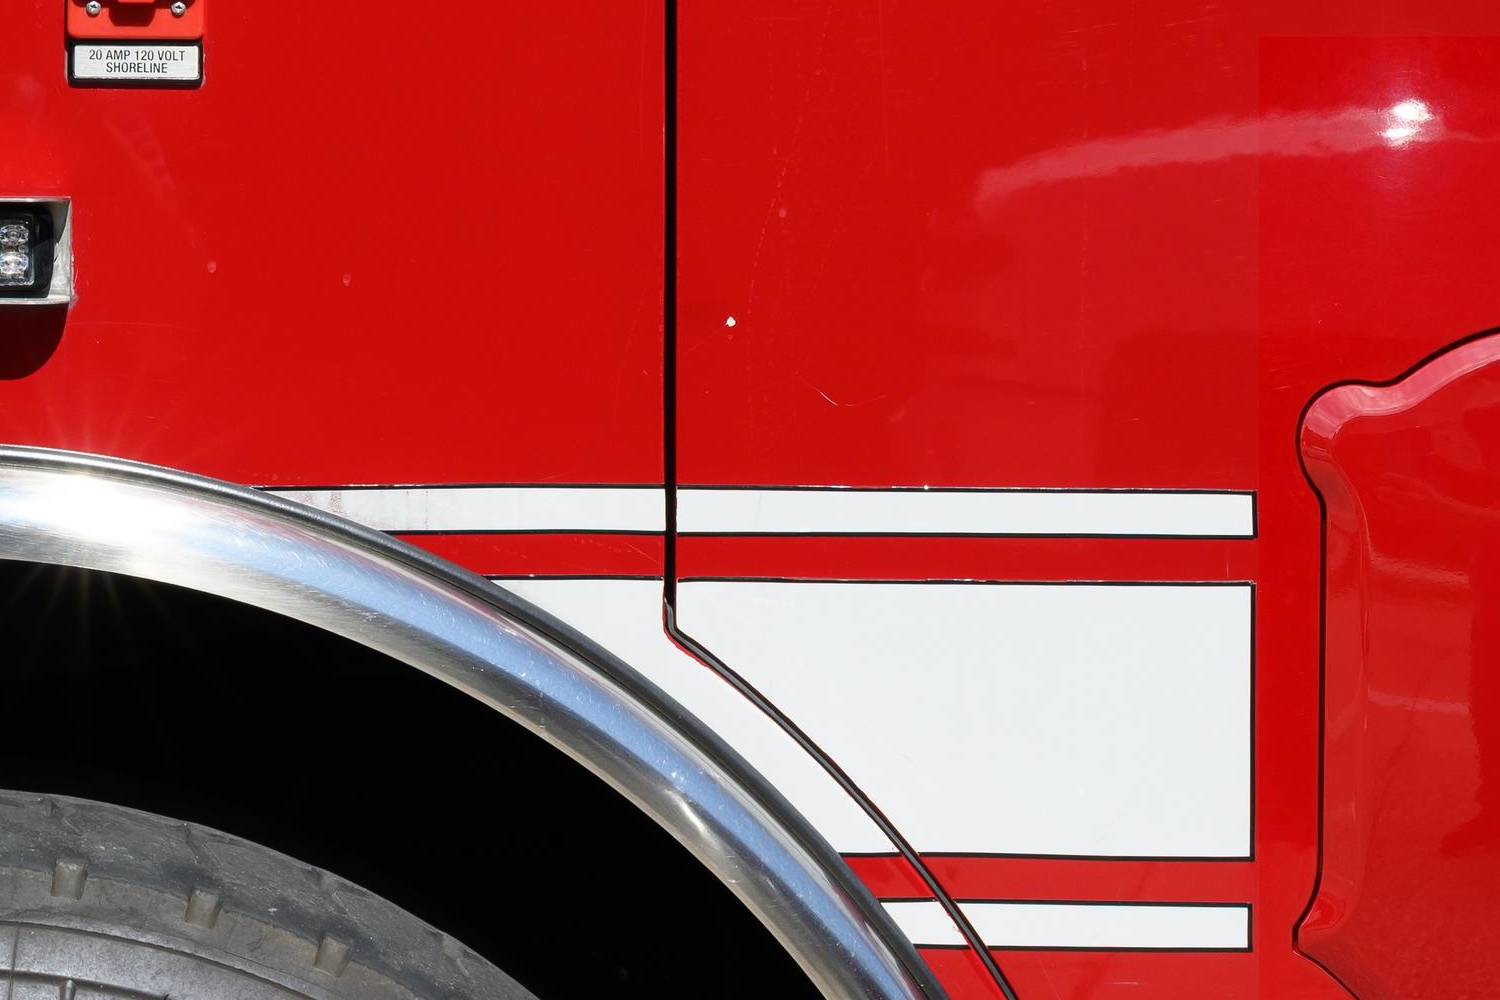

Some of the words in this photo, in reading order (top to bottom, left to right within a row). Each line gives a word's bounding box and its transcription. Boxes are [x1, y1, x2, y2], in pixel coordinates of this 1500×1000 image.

[89, 49, 102, 60] 20
[105, 49, 131, 61] AMP
[134, 50, 155, 61] 120
[158, 50, 186, 62] VOLT
[106, 61, 168, 74] SHORELINE
